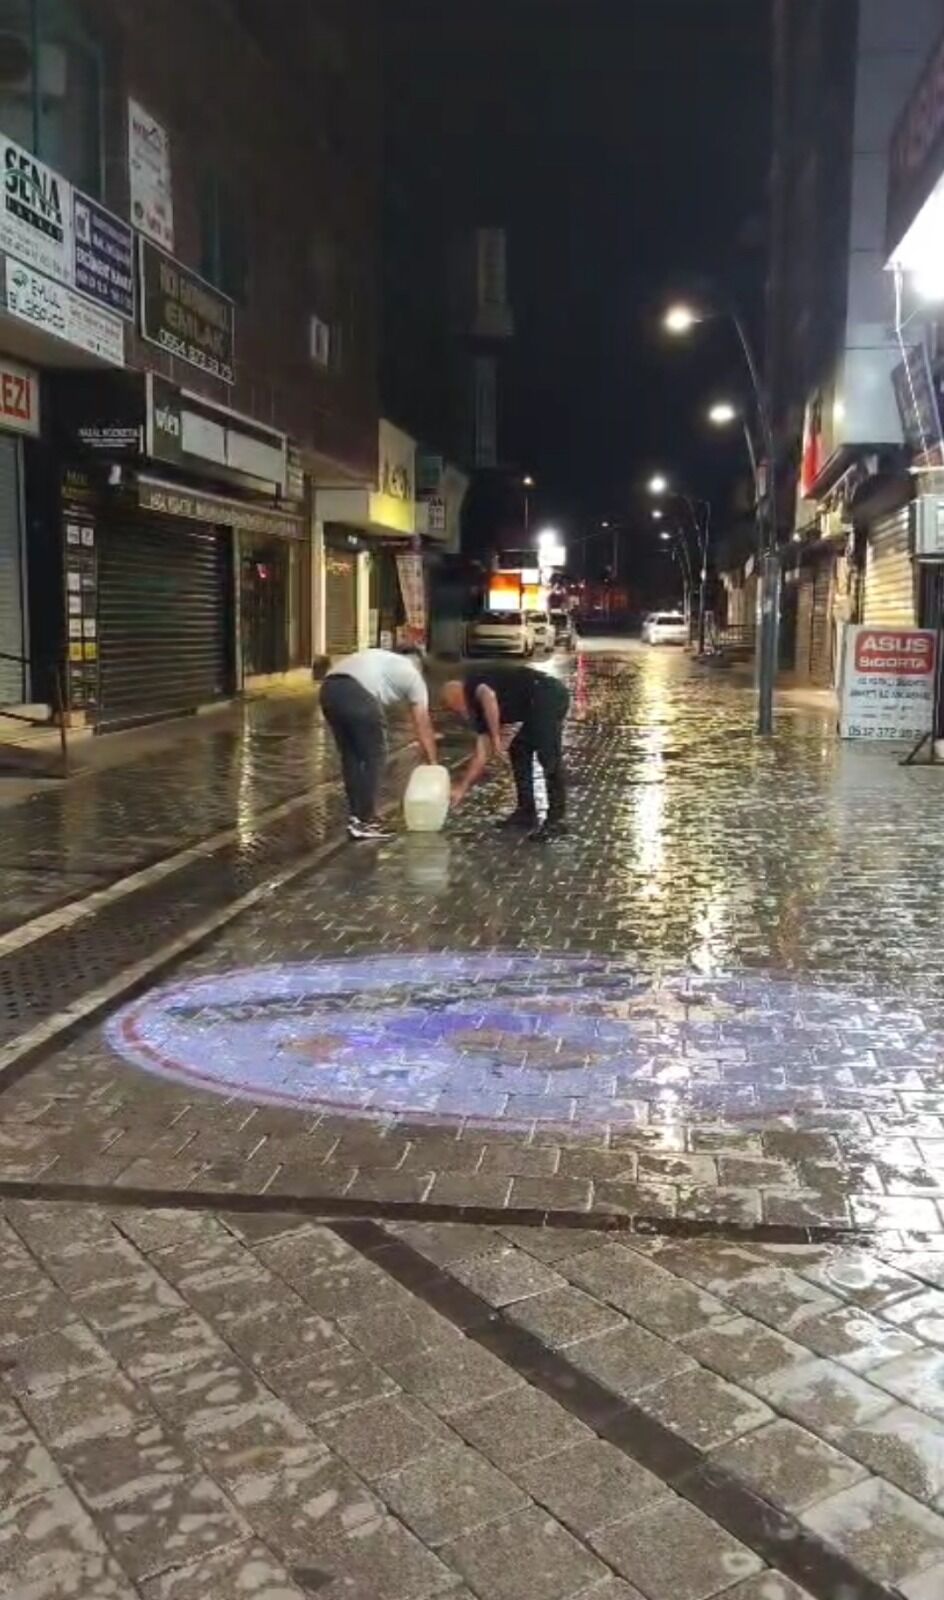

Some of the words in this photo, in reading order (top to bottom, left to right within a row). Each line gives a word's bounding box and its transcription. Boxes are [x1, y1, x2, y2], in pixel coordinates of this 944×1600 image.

[5, 147, 62, 225] SENA
[0, 373, 31, 420] EZİ
[861, 635, 929, 653] ASUS
